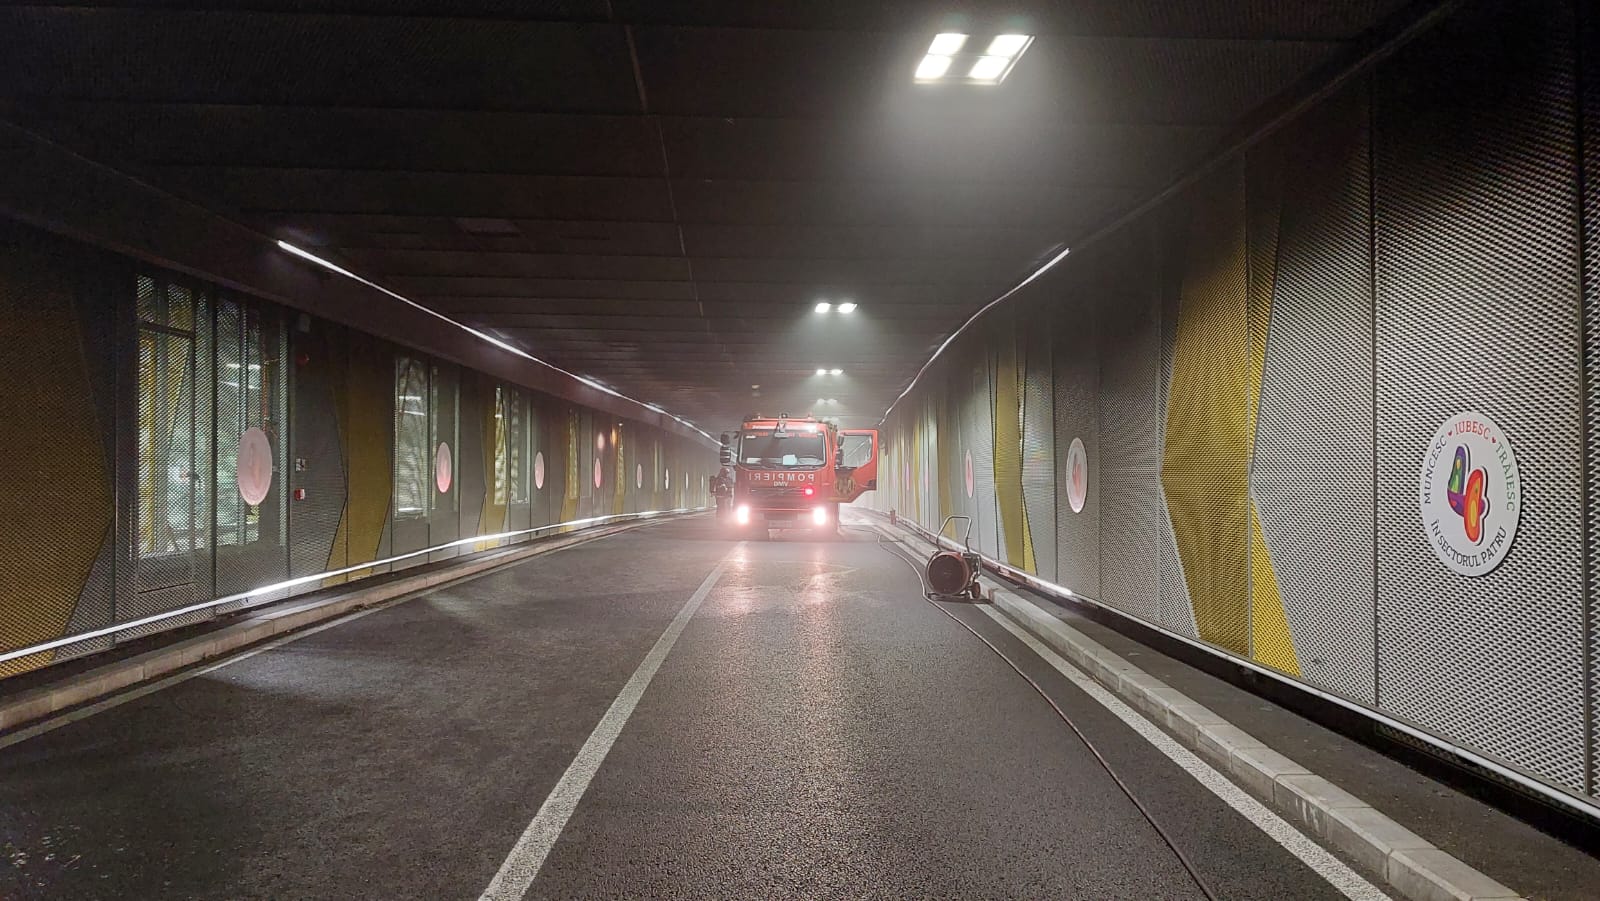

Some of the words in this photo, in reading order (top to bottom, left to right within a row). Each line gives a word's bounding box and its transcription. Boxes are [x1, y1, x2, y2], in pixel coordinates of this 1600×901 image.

[1424, 435, 1447, 504] MUNCESC
[1455, 421, 1490, 440] IUBESC
[1430, 519, 1441, 537] ÎN
[1437, 536, 1481, 568] SECTORUL
[1482, 527, 1507, 564] PATRU
